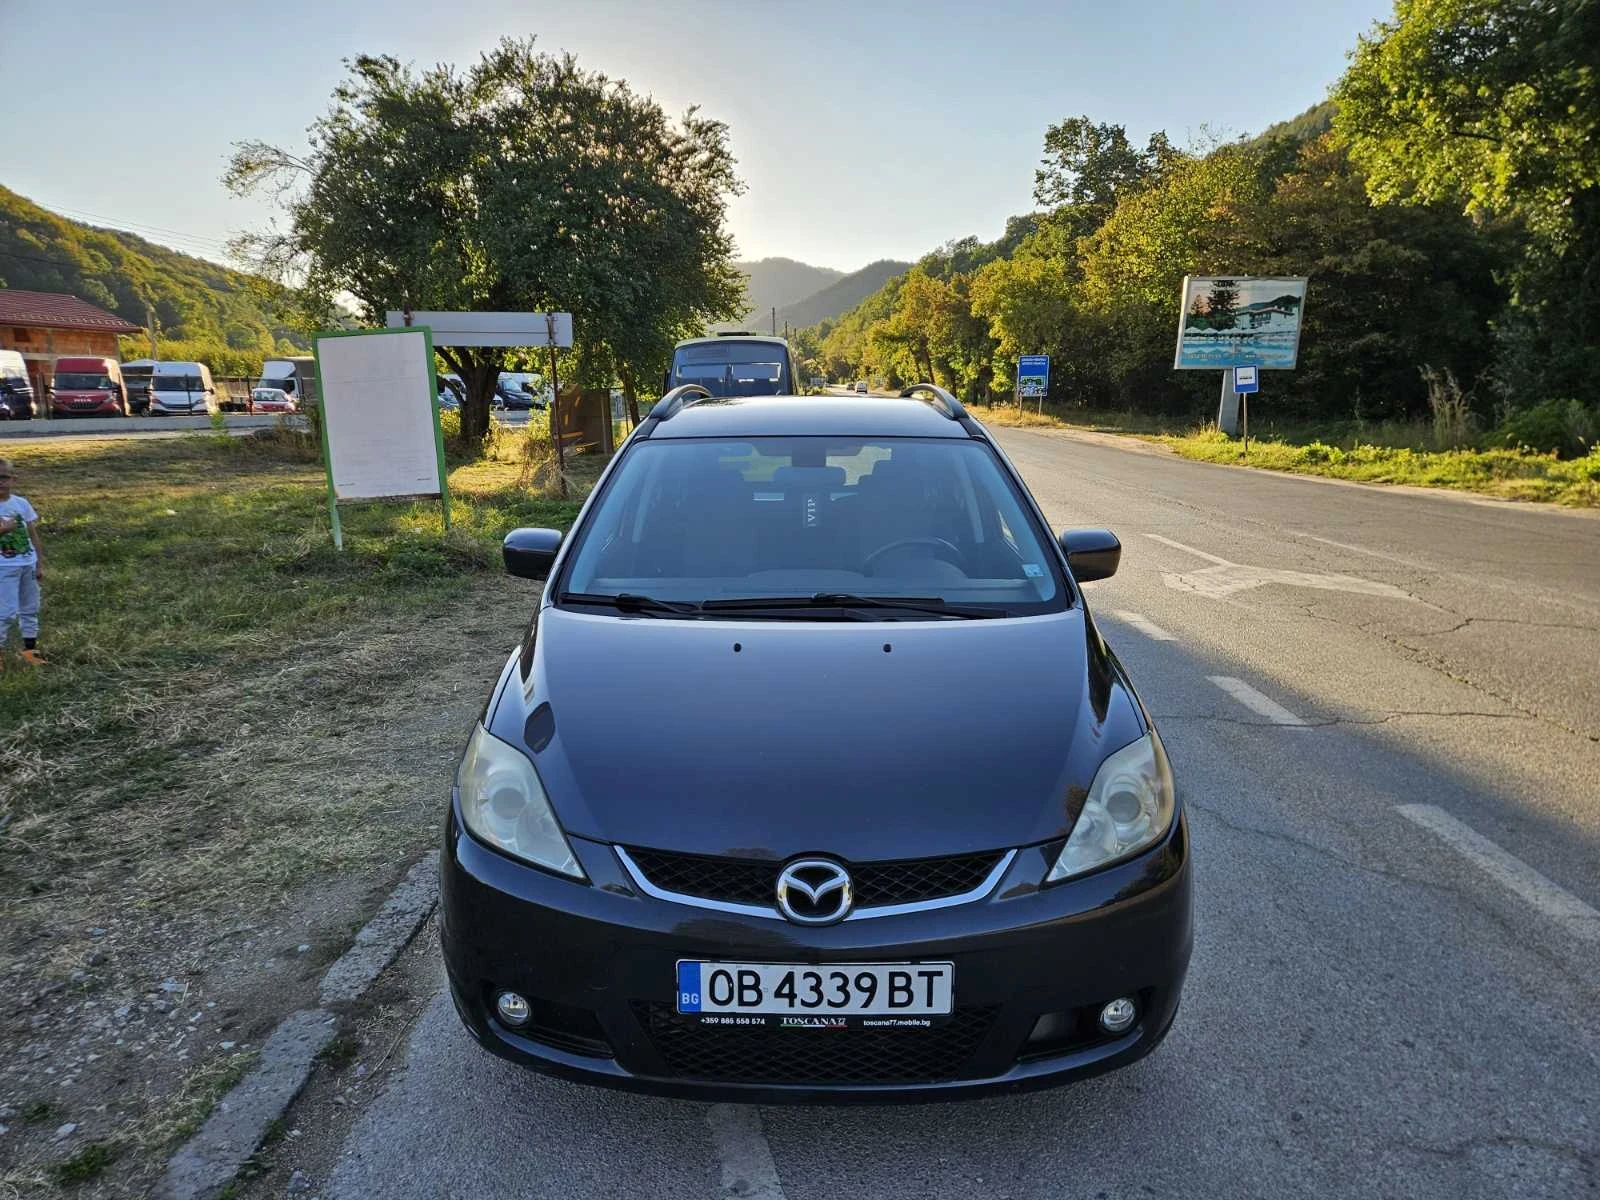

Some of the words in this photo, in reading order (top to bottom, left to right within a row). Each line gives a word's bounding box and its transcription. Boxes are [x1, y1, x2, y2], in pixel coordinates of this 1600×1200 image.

[709, 969, 763, 1007] OB
[774, 971, 878, 1008] 4339
[888, 970, 944, 1008] BT
[681, 993, 699, 1005] BG
[700, 1016, 719, 1024] +359
[863, 1018, 931, 1027] toscana77.mobile.bg
